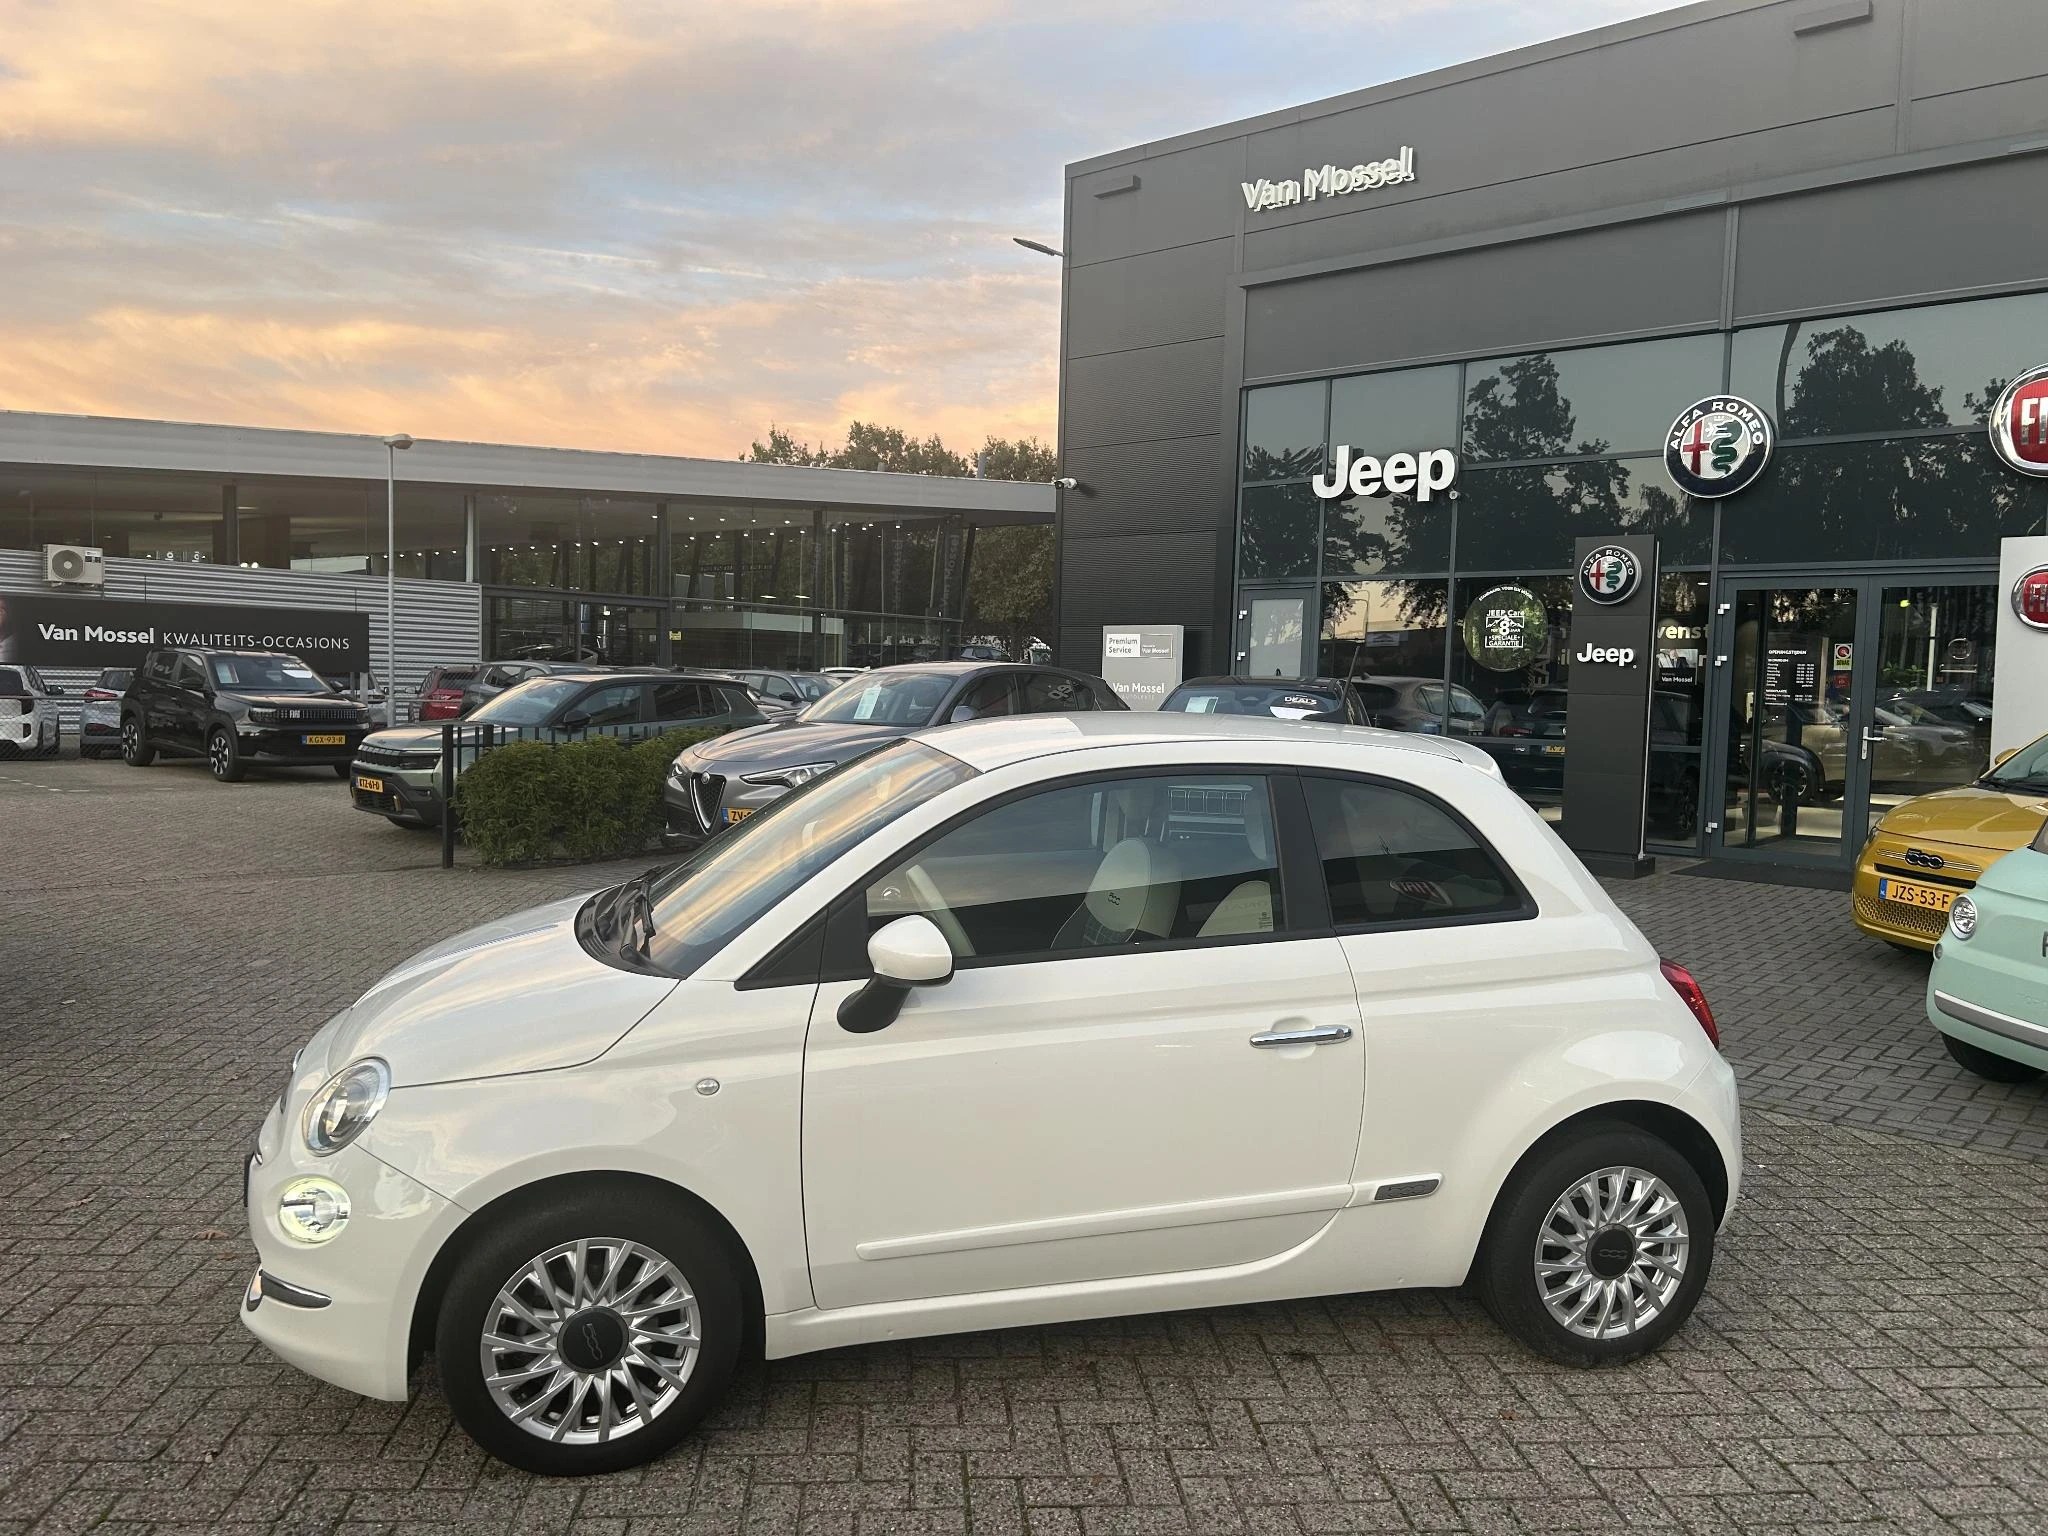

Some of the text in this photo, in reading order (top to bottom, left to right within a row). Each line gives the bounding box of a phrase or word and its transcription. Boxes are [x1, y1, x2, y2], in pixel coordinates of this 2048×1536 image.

[1241, 146, 1415, 212] Van Mossel
[1670, 401, 1764, 450] ALFA ROMEO
[2021, 397, 2048, 446] FI
[1312, 444, 1456, 502] Jeep
[1583, 549, 1634, 576] ALFA ROMEO
[2030, 583, 2048, 613] FI
[1486, 609, 1525, 617] JEEP Care
[38, 623, 350, 650] Van Mossel KWALITEITS-OCCASIONS
[1499, 620, 1510, 636] 8
[1108, 637, 1138, 645] Premium
[1108, 646, 1132, 654] Service
[1576, 642, 1634, 667] Jeep
[1112, 682, 1165, 694] Van Mossel
[1905, 848, 1943, 870] 500
[1891, 884, 1950, 909] JZS-53-F
